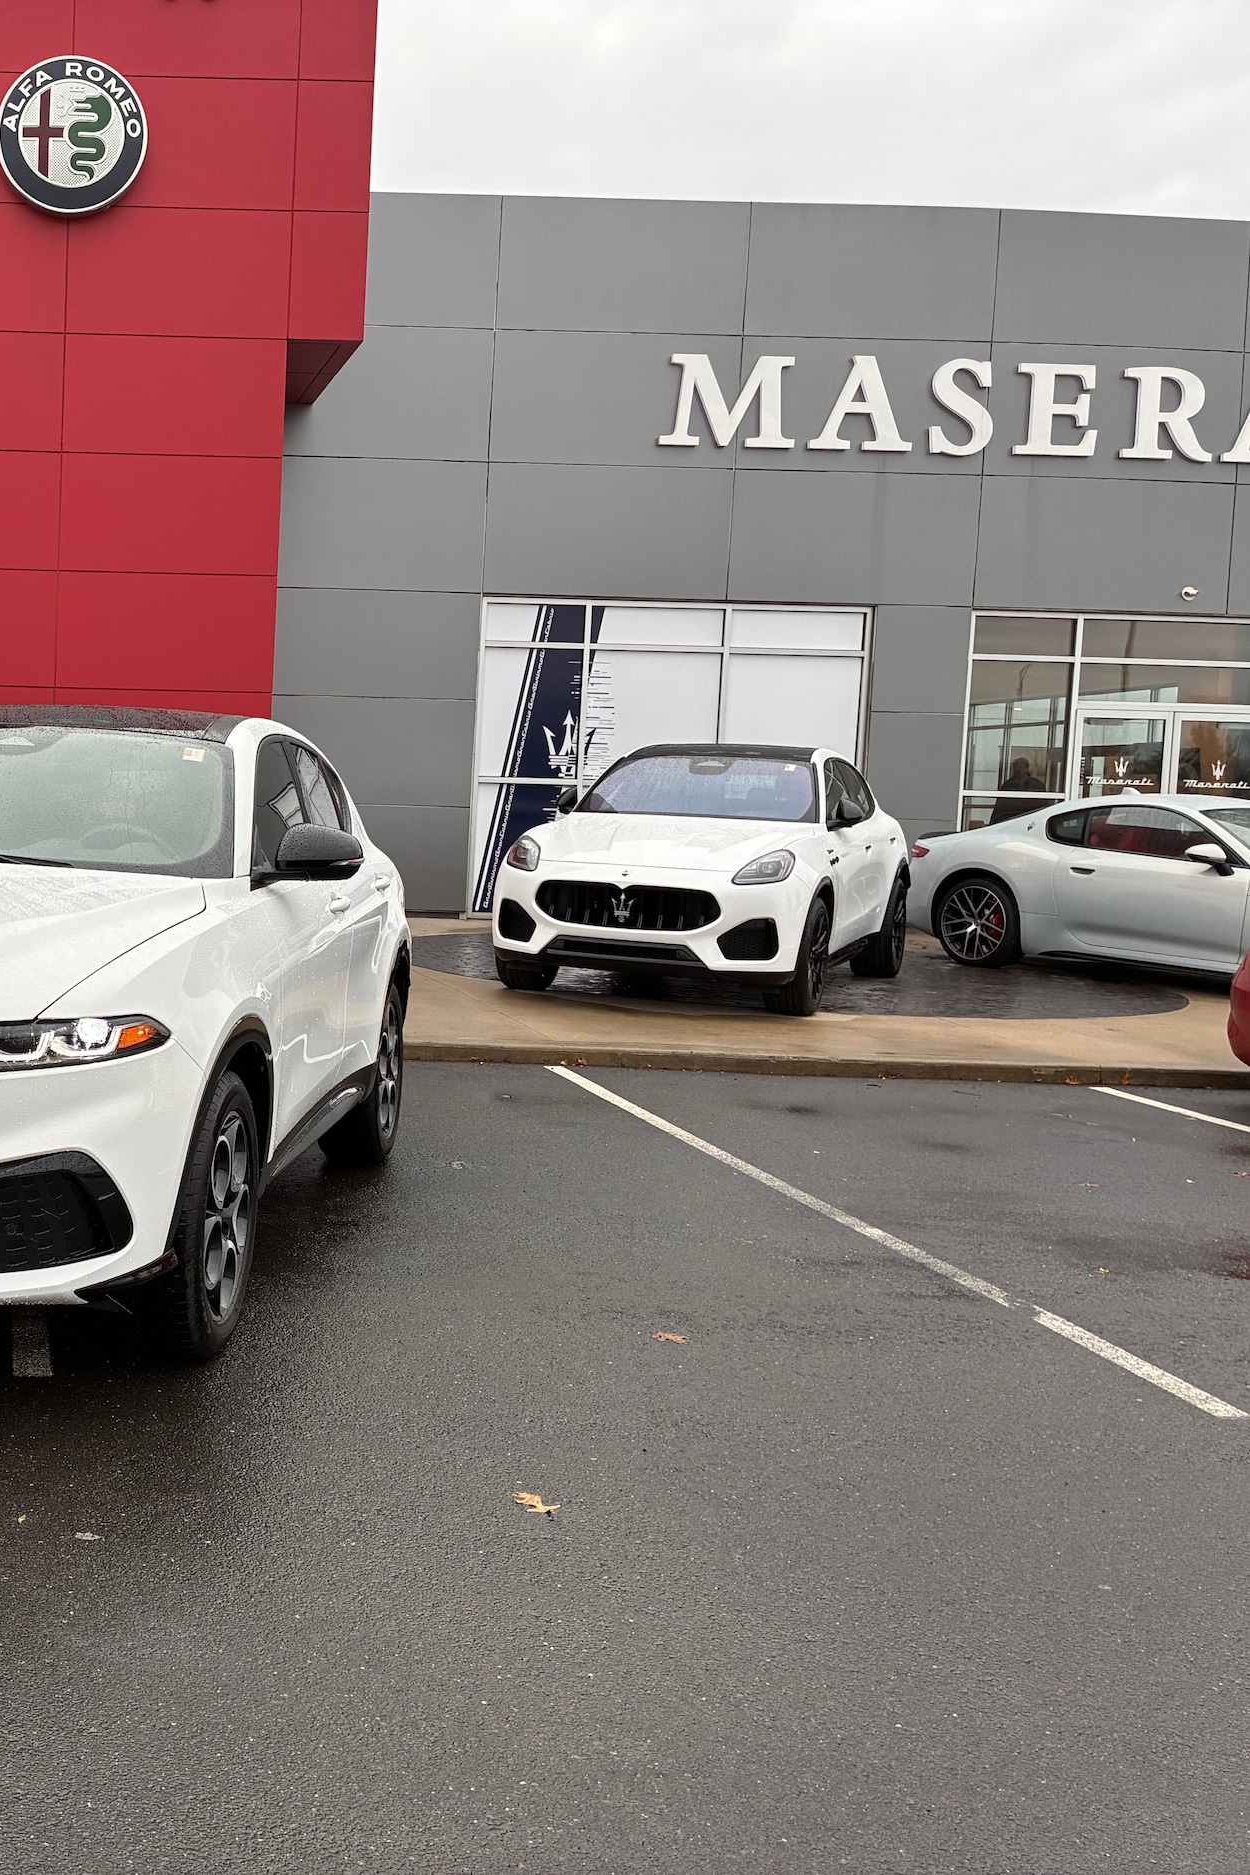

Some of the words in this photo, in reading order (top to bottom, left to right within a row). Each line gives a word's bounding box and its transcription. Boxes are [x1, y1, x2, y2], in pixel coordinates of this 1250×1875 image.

[2, 70, 53, 133] ALFA
[65, 62, 142, 139] ROMEO
[1085, 776, 1155, 786] Maserati
[1183, 779, 1250, 789] Maserati
